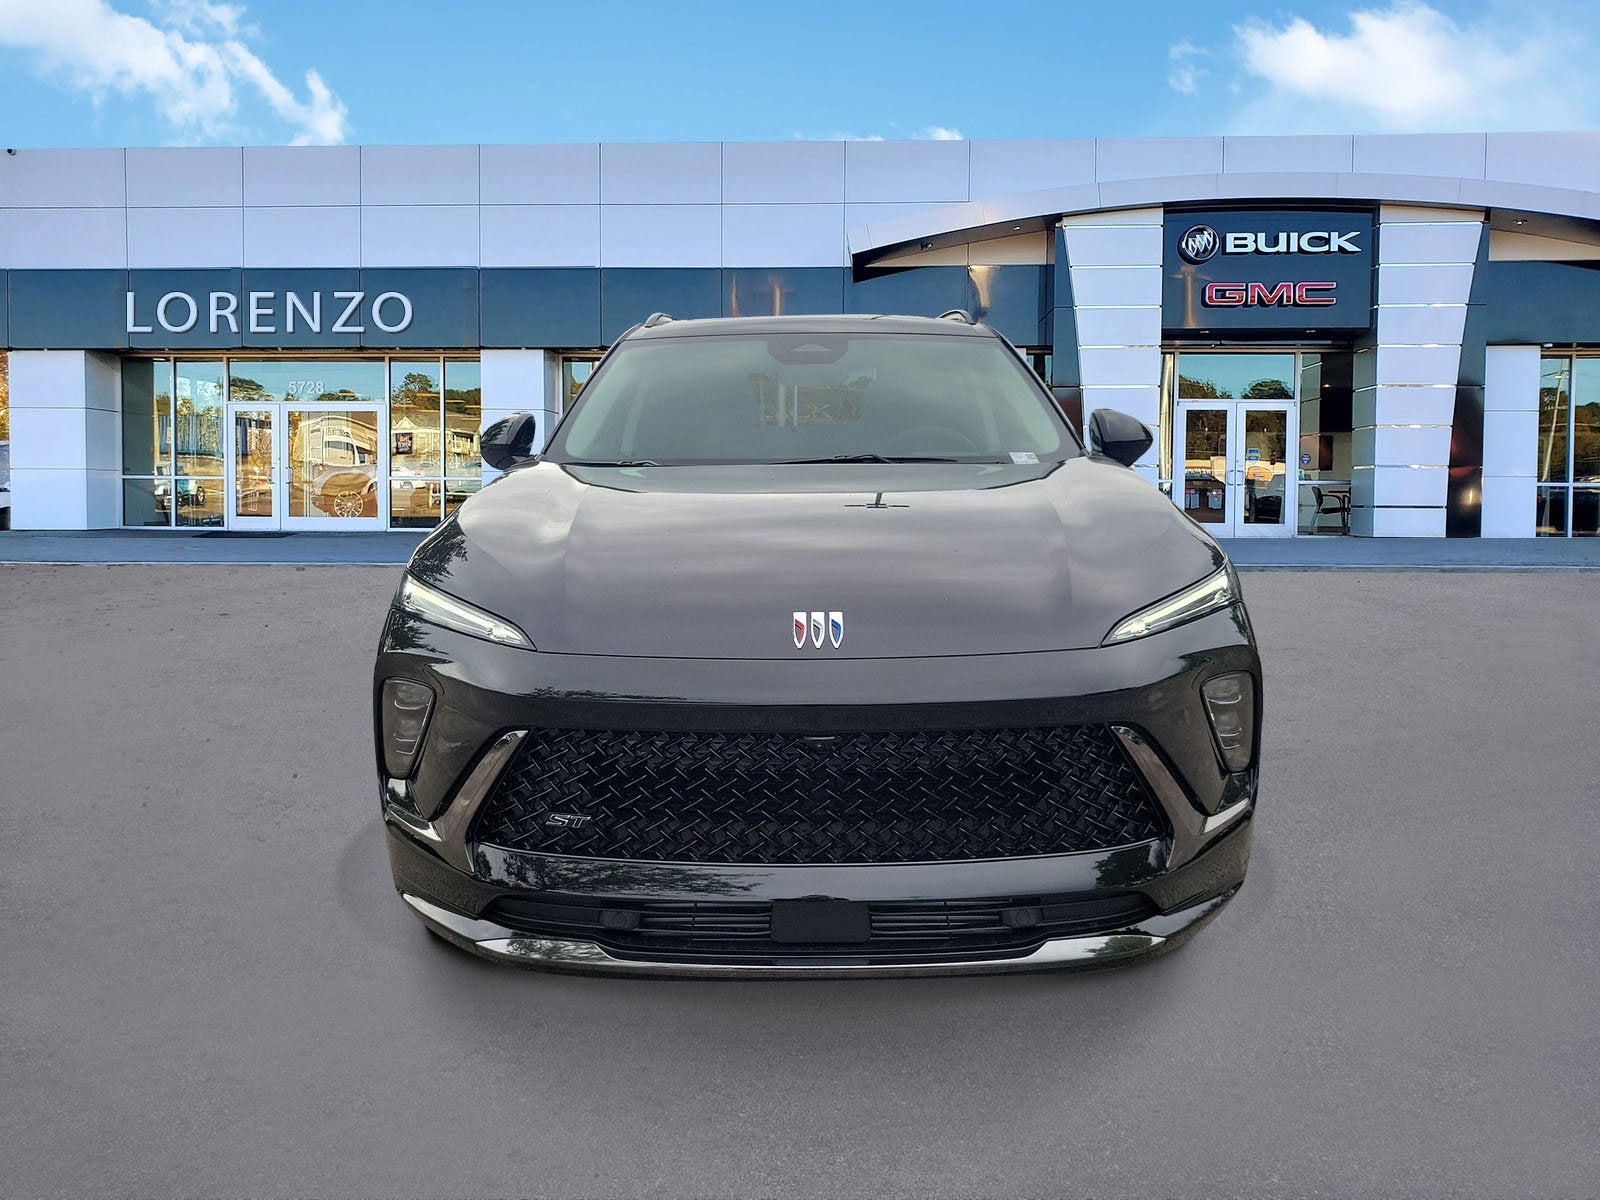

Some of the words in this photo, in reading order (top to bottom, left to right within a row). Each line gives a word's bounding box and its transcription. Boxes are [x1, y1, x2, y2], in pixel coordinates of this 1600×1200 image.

[1225, 231, 1362, 253] BUICK
[1205, 281, 1337, 305] GMC
[126, 291, 413, 333] LORENZO
[288, 380, 326, 394] 5728
[545, 813, 592, 828] ST
